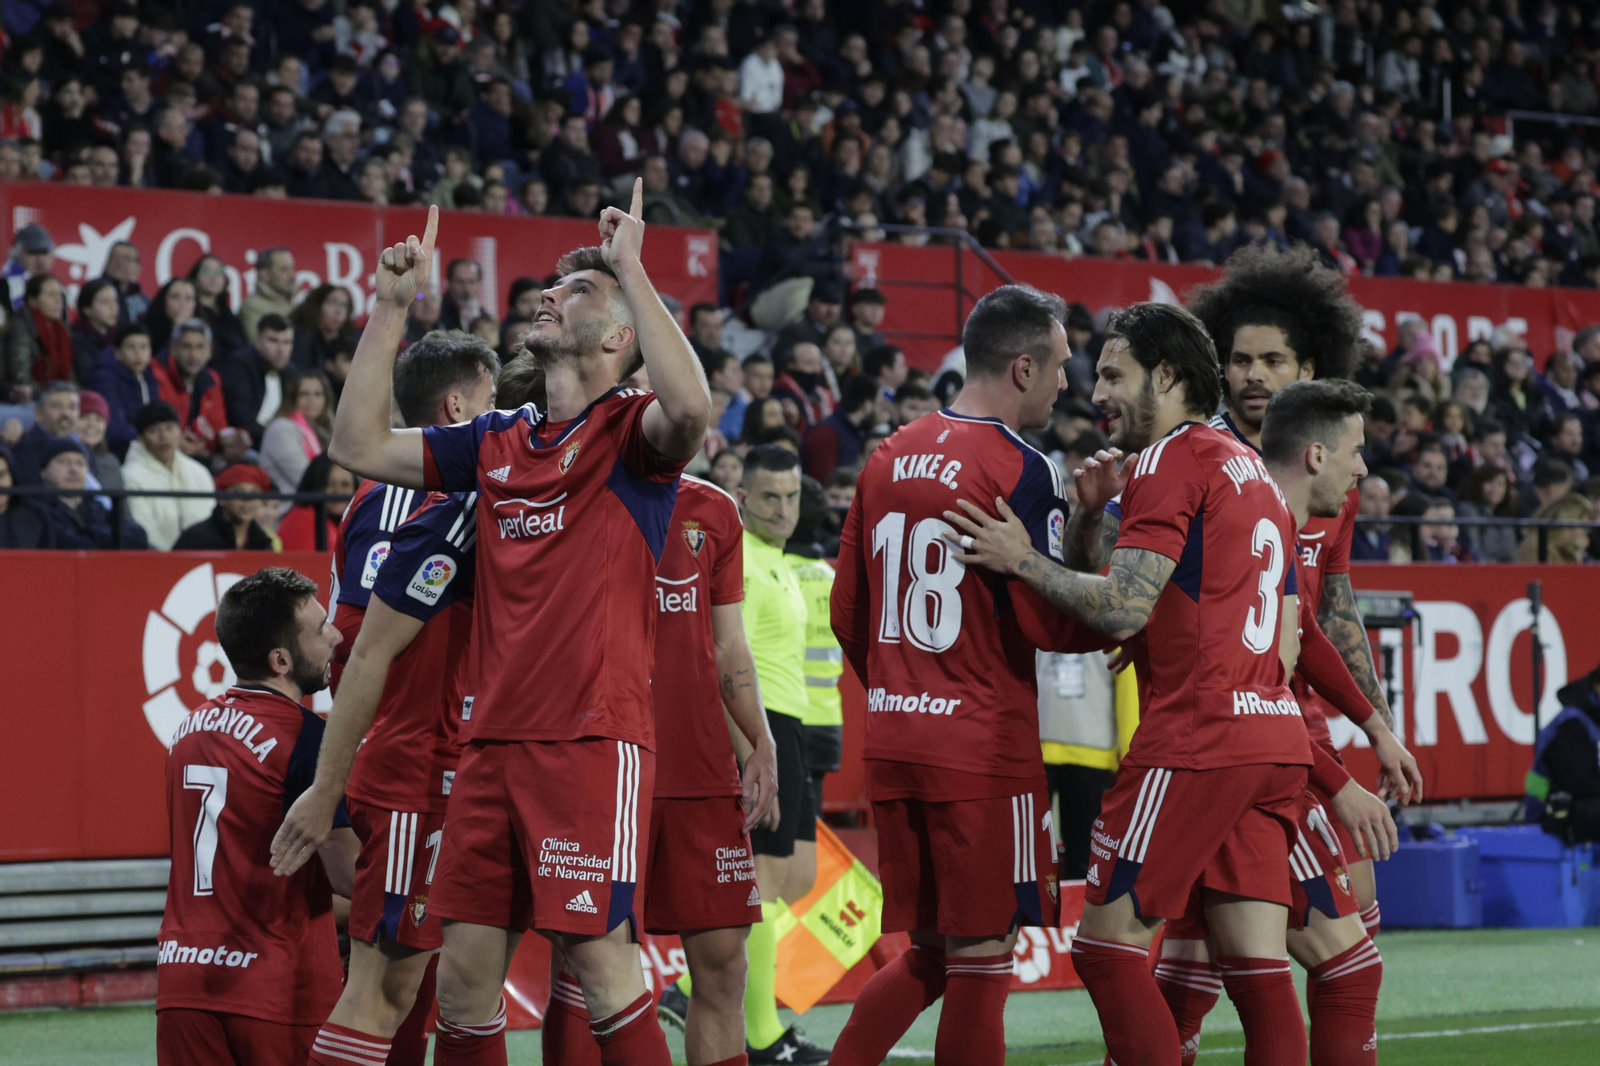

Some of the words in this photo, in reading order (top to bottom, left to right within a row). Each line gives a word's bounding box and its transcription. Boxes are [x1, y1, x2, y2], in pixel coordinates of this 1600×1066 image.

[892, 454, 945, 482] KIKE
[939, 460, 962, 490] G.
[1222, 455, 1259, 495] JUAN
[498, 505, 565, 539] verleal
[411, 581, 438, 600] LaLiga
[872, 511, 966, 653] 18
[1241, 517, 1284, 655] 3
[655, 586, 697, 613] leal
[867, 687, 961, 716] HRmotor
[1232, 690, 1302, 717] HRmoto
[183, 764, 228, 897] 7
[541, 837, 580, 852] Clínica
[715, 846, 748, 860] Clínica
[537, 863, 552, 877] de
[555, 865, 604, 883] Navarra
[539, 849, 612, 870] Universidad
[717, 871, 731, 884] de
[565, 902, 598, 914] adidas
[156, 940, 258, 968] HRmotor
